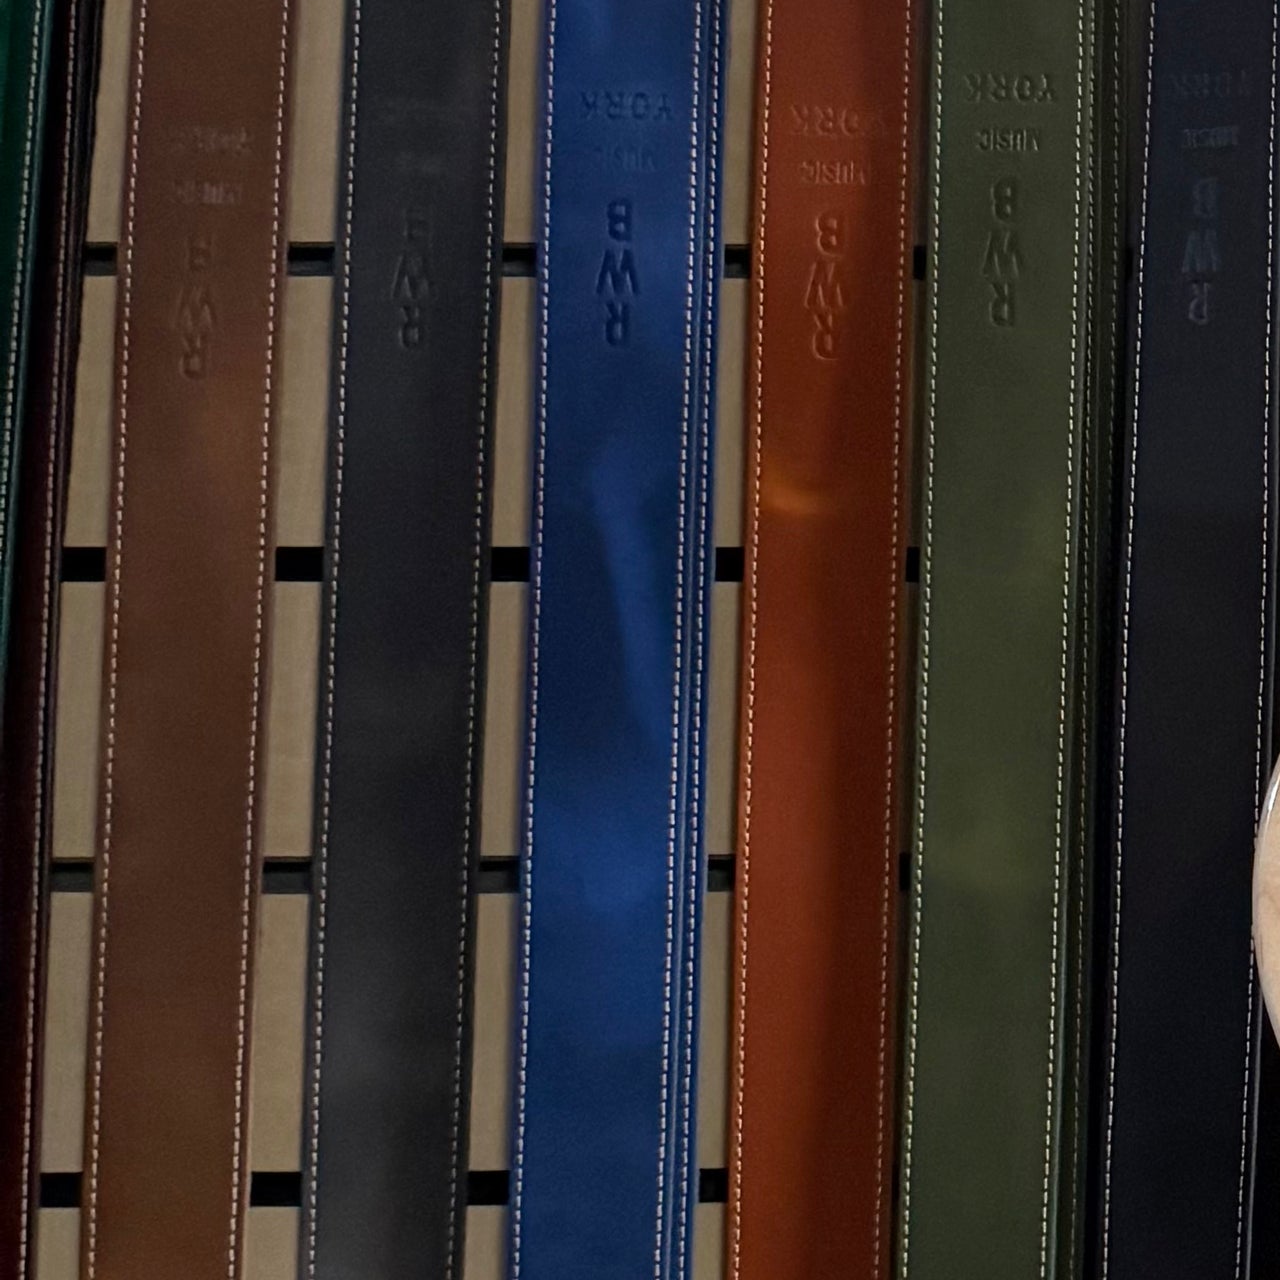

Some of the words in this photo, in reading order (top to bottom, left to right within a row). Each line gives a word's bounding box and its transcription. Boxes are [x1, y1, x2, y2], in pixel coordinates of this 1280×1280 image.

[964, 72, 1054, 104] YORK
[580, 91, 672, 120] YORK
[976, 127, 1040, 152] MUSIC
